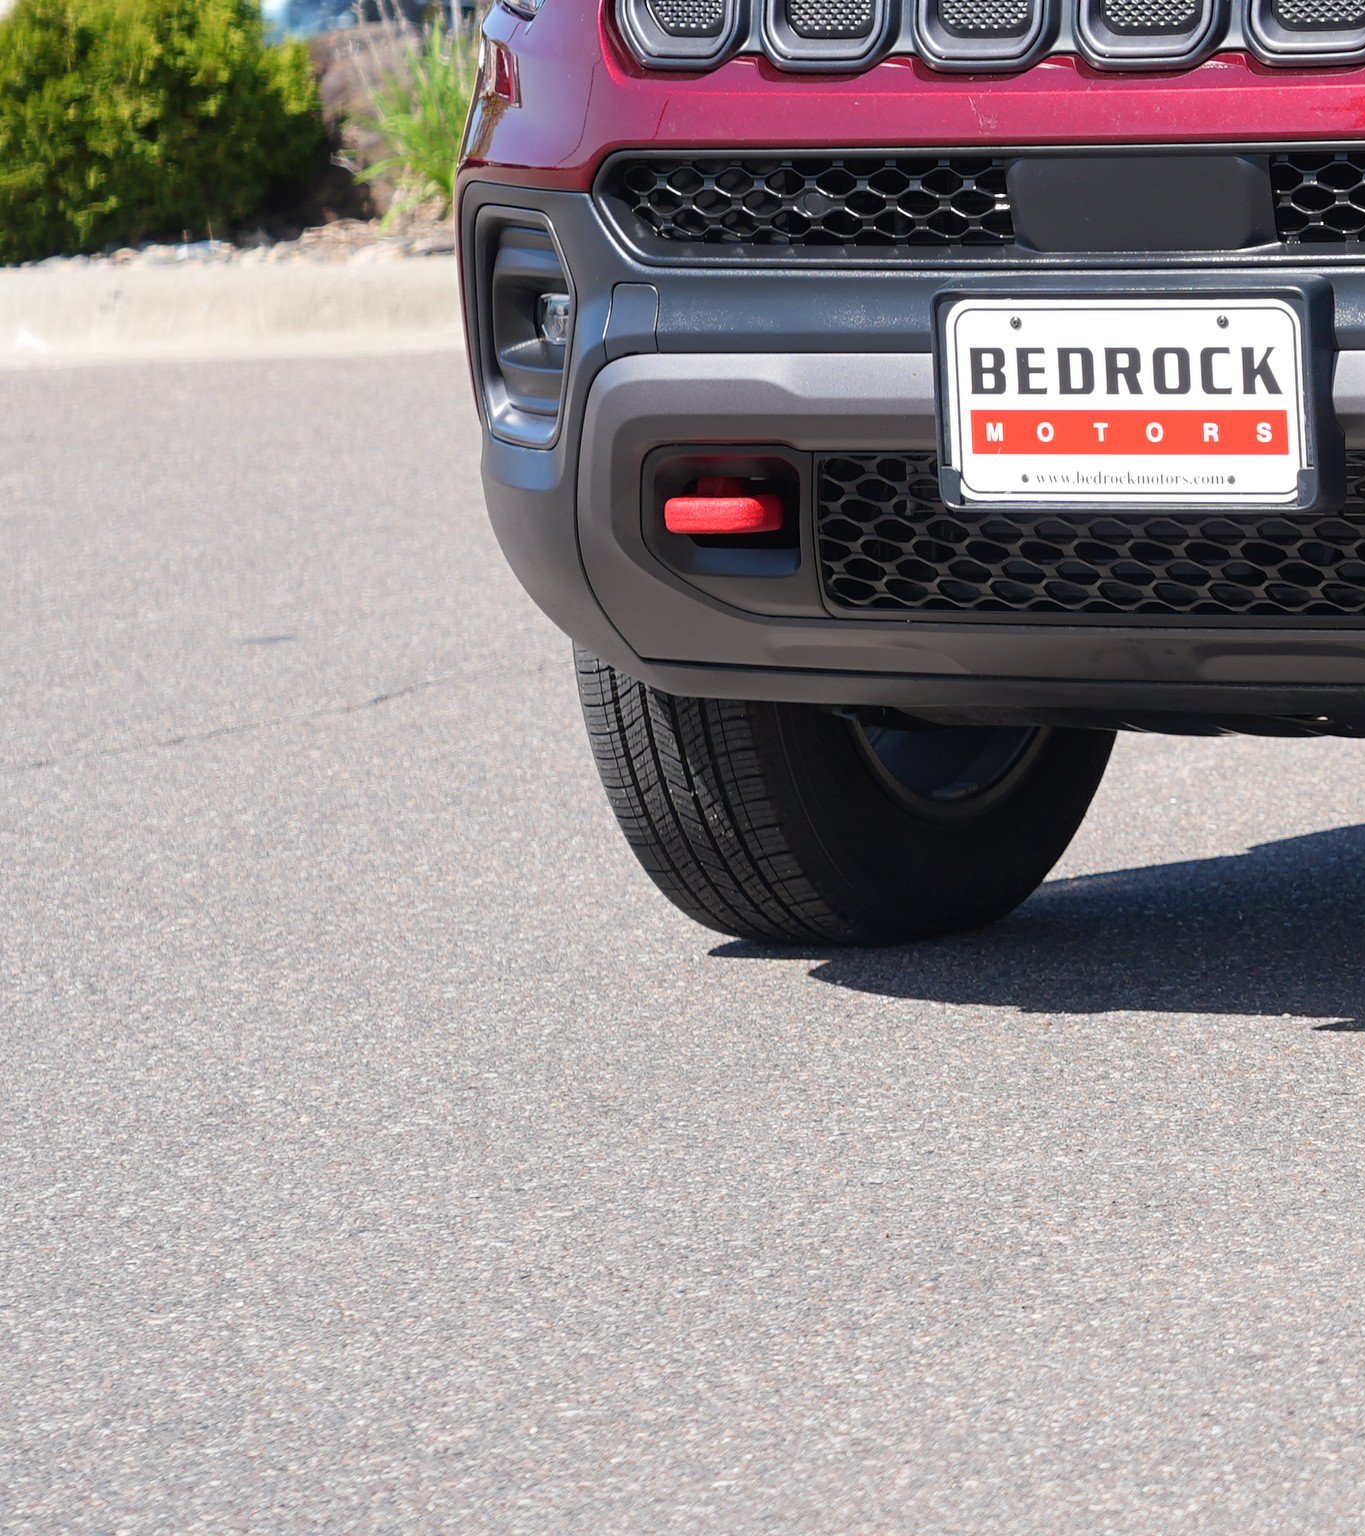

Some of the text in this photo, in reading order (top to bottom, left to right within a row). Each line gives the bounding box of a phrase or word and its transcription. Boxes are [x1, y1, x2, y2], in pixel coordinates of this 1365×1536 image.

[968, 346, 1284, 395] BEDROCK
[985, 421, 1274, 443] MOTORS
[1036, 470, 1226, 486] www.bedrockmotors.com
